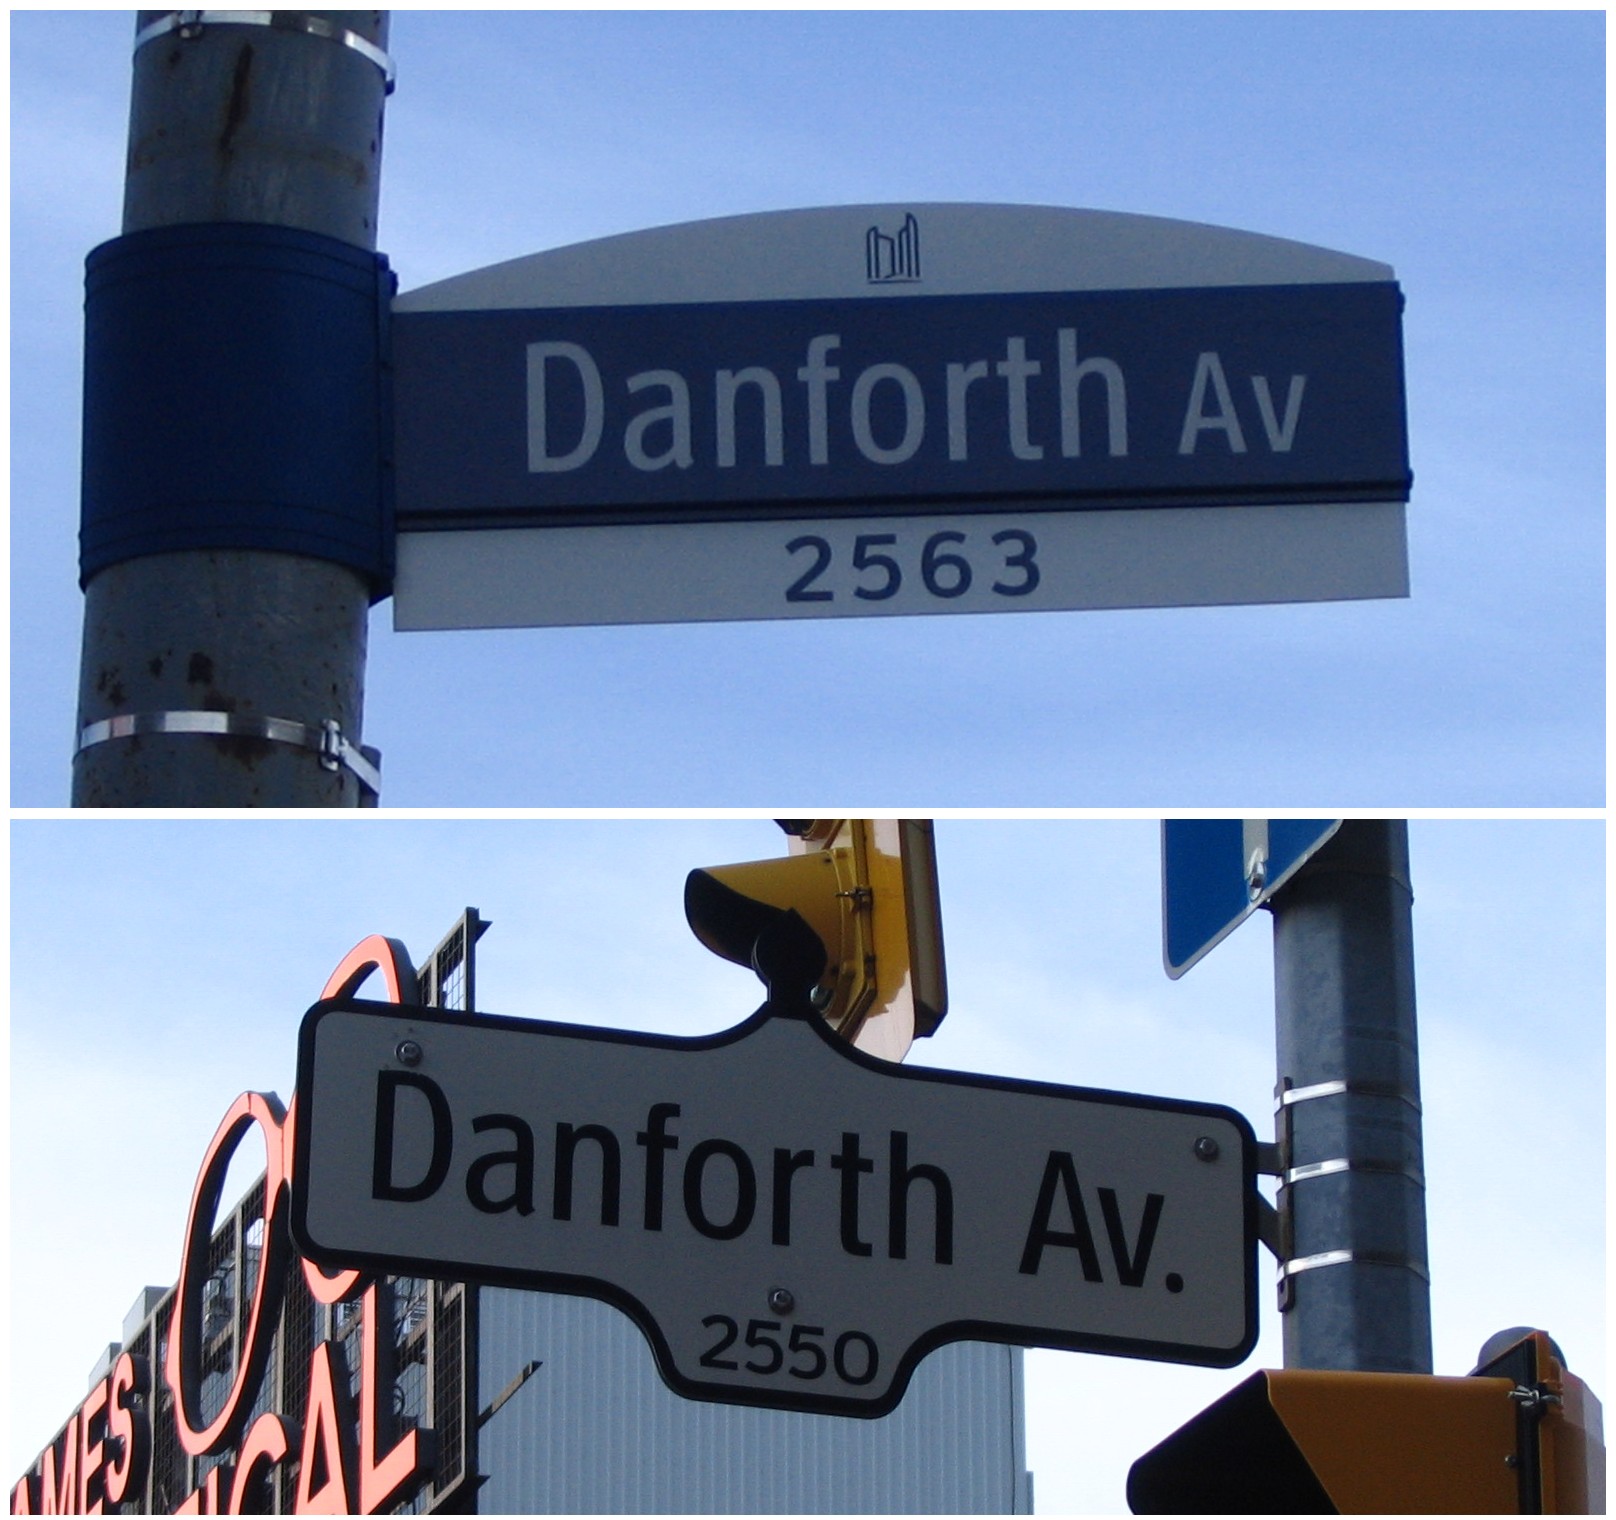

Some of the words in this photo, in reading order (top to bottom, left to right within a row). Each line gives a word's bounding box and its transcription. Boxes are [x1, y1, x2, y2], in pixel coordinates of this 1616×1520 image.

[525, 329, 1129, 474] Danforth
[1178, 352, 1308, 455] Av
[784, 529, 1043, 603] 2563
[371, 1069, 955, 1265] Danforth
[1017, 1150, 1185, 1294] Av.
[171, 1283, 417, 1515] CAL
[700, 1314, 880, 1386] 2550
[13, 1352, 134, 1515] MES
